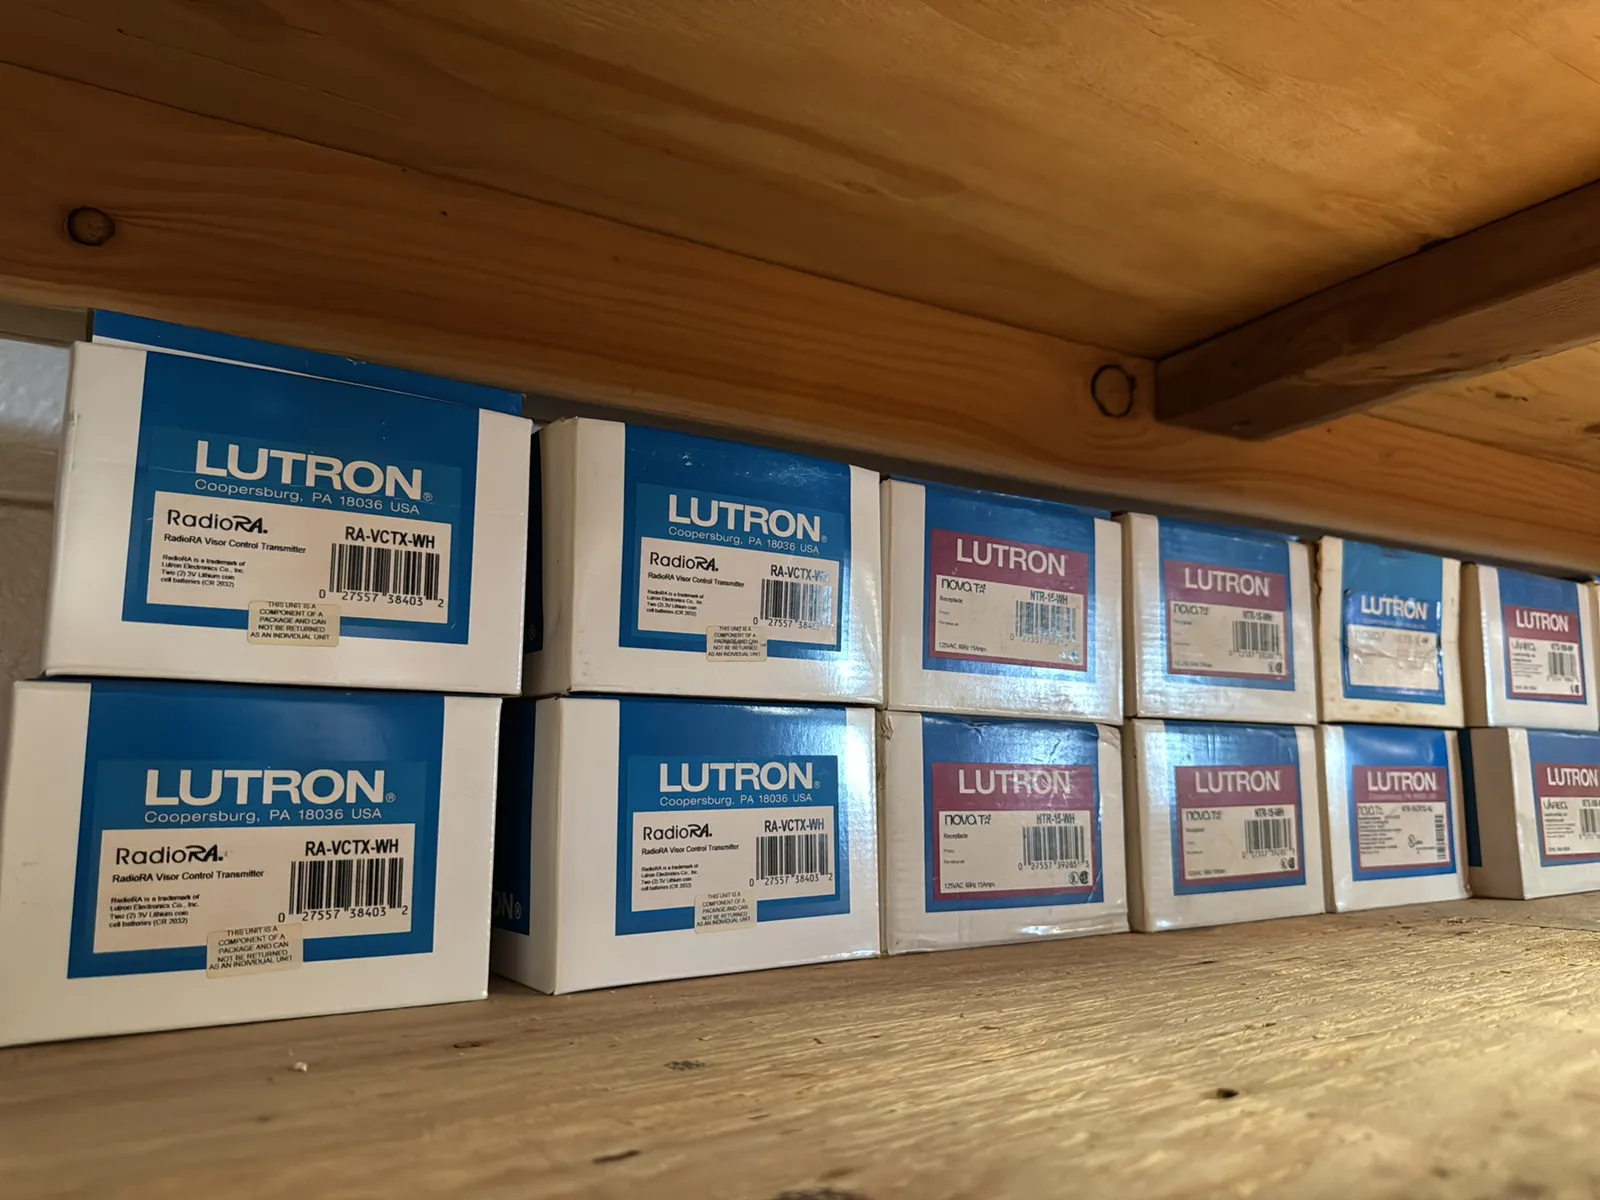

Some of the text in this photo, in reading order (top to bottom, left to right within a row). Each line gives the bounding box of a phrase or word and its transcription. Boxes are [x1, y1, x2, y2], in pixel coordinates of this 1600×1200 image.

[195, 439, 422, 500] LUTRON
[194, 478, 419, 514] Coopersburg, PA 18036 USA
[669, 493, 821, 542] LUTRON
[163, 533, 306, 554] RadioRA Visor Control Transmitter
[344, 526, 435, 549] RA-VCTX-WH
[668, 526, 819, 554] Coopersburg, PA 18036 USA
[957, 538, 1065, 576] LUTRON
[647, 571, 744, 588] RadioRA Visor Control Transmitter
[1185, 567, 1270, 597] LUTRON
[318, 589, 444, 608] 0 27557 38403 2
[1361, 595, 1427, 621] LUTRON
[752, 617, 792, 628] 0 27557
[1516, 609, 1568, 633] LUTRON
[145, 768, 384, 806] LUTRON
[660, 762, 812, 792] LUTRON
[959, 769, 1071, 794] LUTRON
[1195, 770, 1281, 793] LUTRON
[1367, 770, 1437, 791] LUTRON
[1547, 767, 1599, 787] LUTRON
[660, 793, 812, 807] Coopersburg, PA 18036 USA
[144, 808, 381, 823] Coopersburg, PA 18036 USA
[764, 818, 824, 832] RA-VCTX-WH
[304, 838, 398, 856] RA-VCTX-WH
[641, 847, 668, 855] RadioRA
[708, 843, 738, 851] Transmitter
[112, 869, 264, 883] RadioRA Visor Control Transmitter
[749, 872, 832, 887] 0 27557 38403 2
[277, 905, 408, 923] 0 27557 38403 2
